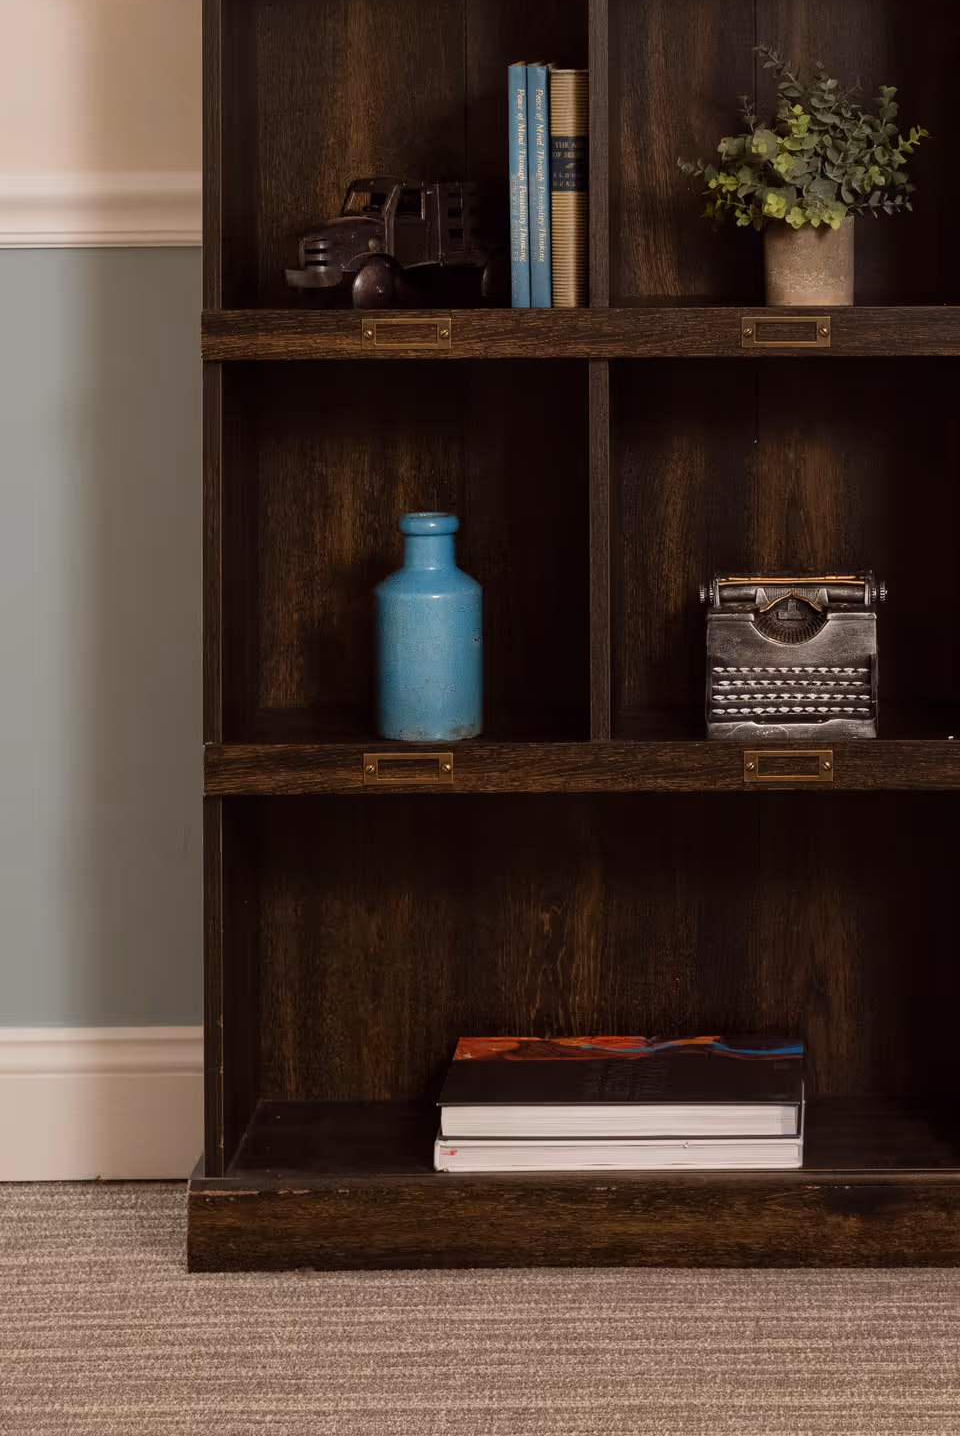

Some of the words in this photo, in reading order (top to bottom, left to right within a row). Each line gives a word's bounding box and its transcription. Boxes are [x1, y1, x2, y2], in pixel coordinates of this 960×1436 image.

[517, 88, 525, 109] Peace
[536, 88, 544, 110] Peace
[518, 123, 526, 145] Mind
[536, 124, 544, 146] Mind
[518, 148, 527, 181] Through
[536, 149, 545, 182] Through
[519, 185, 527, 224] Possibility
[519, 227, 528, 262] Thinking
